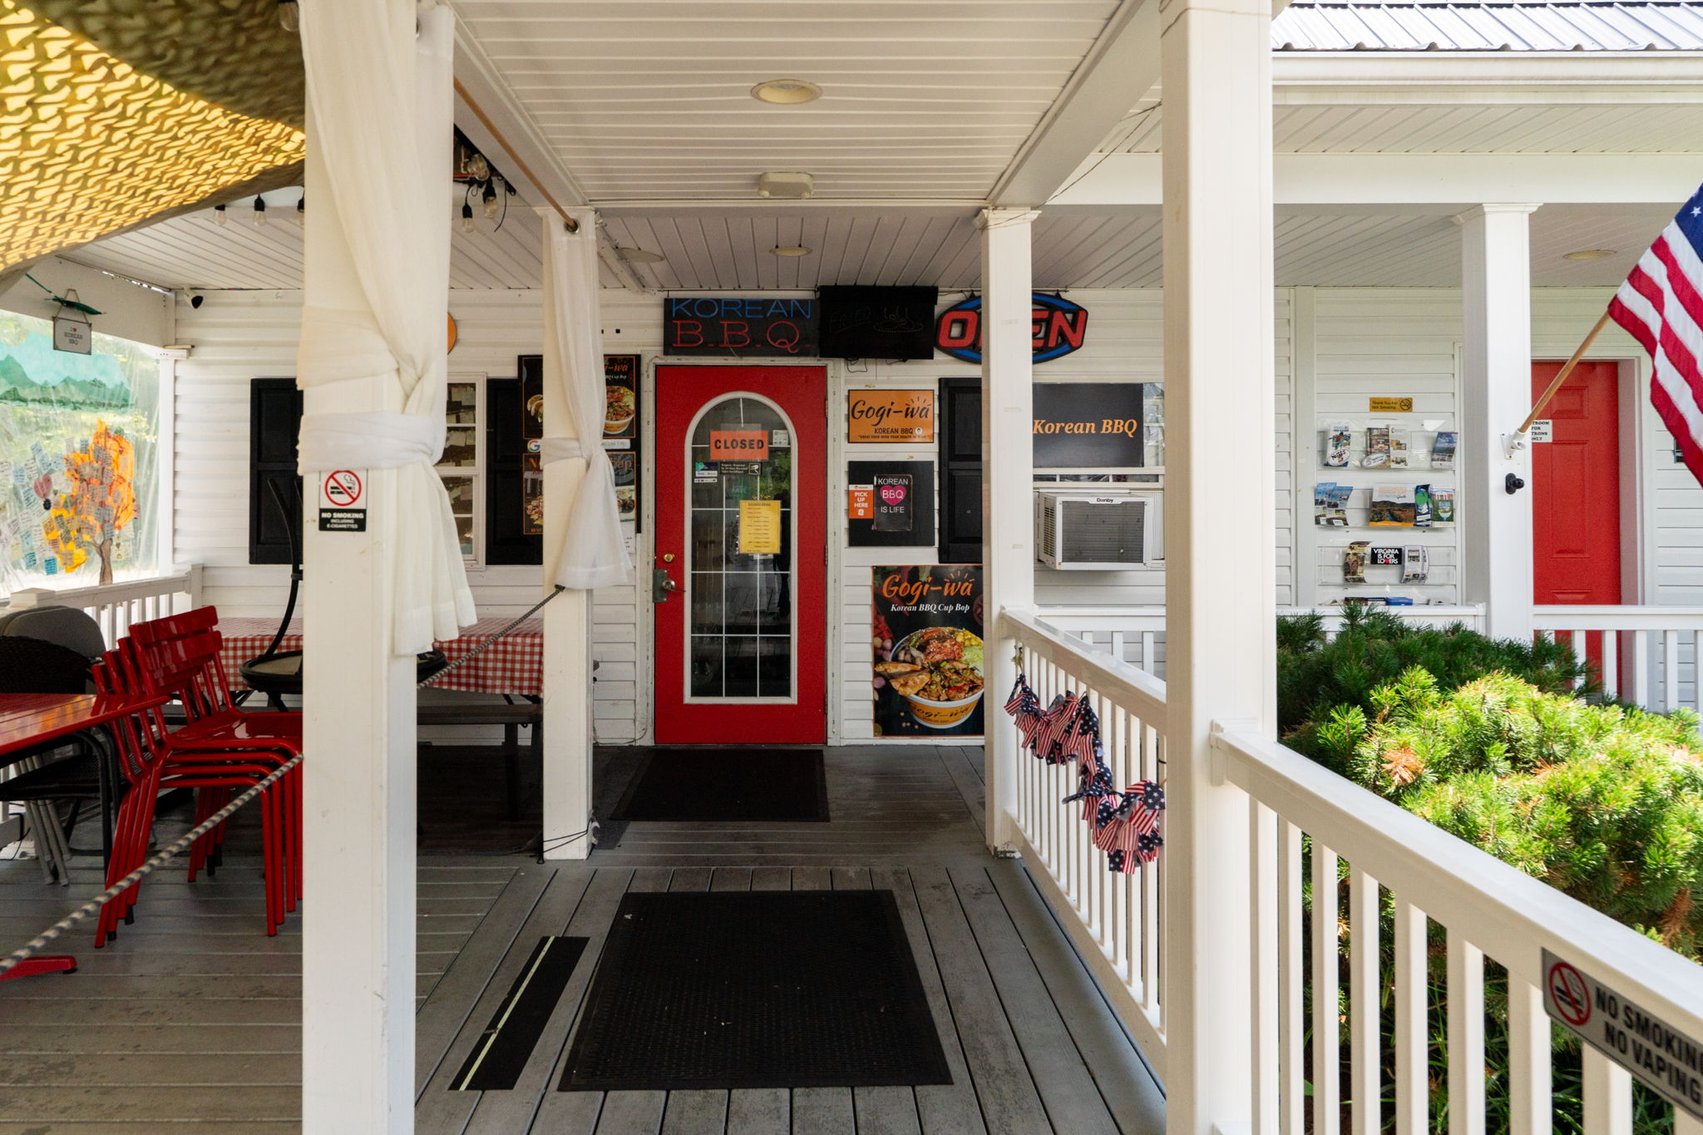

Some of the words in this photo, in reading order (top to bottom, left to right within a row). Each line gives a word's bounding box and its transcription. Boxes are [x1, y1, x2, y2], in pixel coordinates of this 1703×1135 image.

[672, 299, 811, 319] KOREAN
[937, 310, 1088, 348] OEN
[1033, 419, 1096, 434] Korean
[1101, 419, 1137, 437] BBQ
[714, 439, 764, 449] CLOSED
[882, 490, 904, 499] BBQ
[890, 604, 917, 612] Korean
[919, 604, 938, 614] BBQ
[938, 604, 953, 613] Cup
[955, 604, 970, 613] Bop
[1595, 986, 1618, 1020] NO
[1624, 1005, 1703, 1077] SMOKIN
[1604, 1021, 1628, 1056] NO
[1631, 1038, 1701, 1105] VAPING
